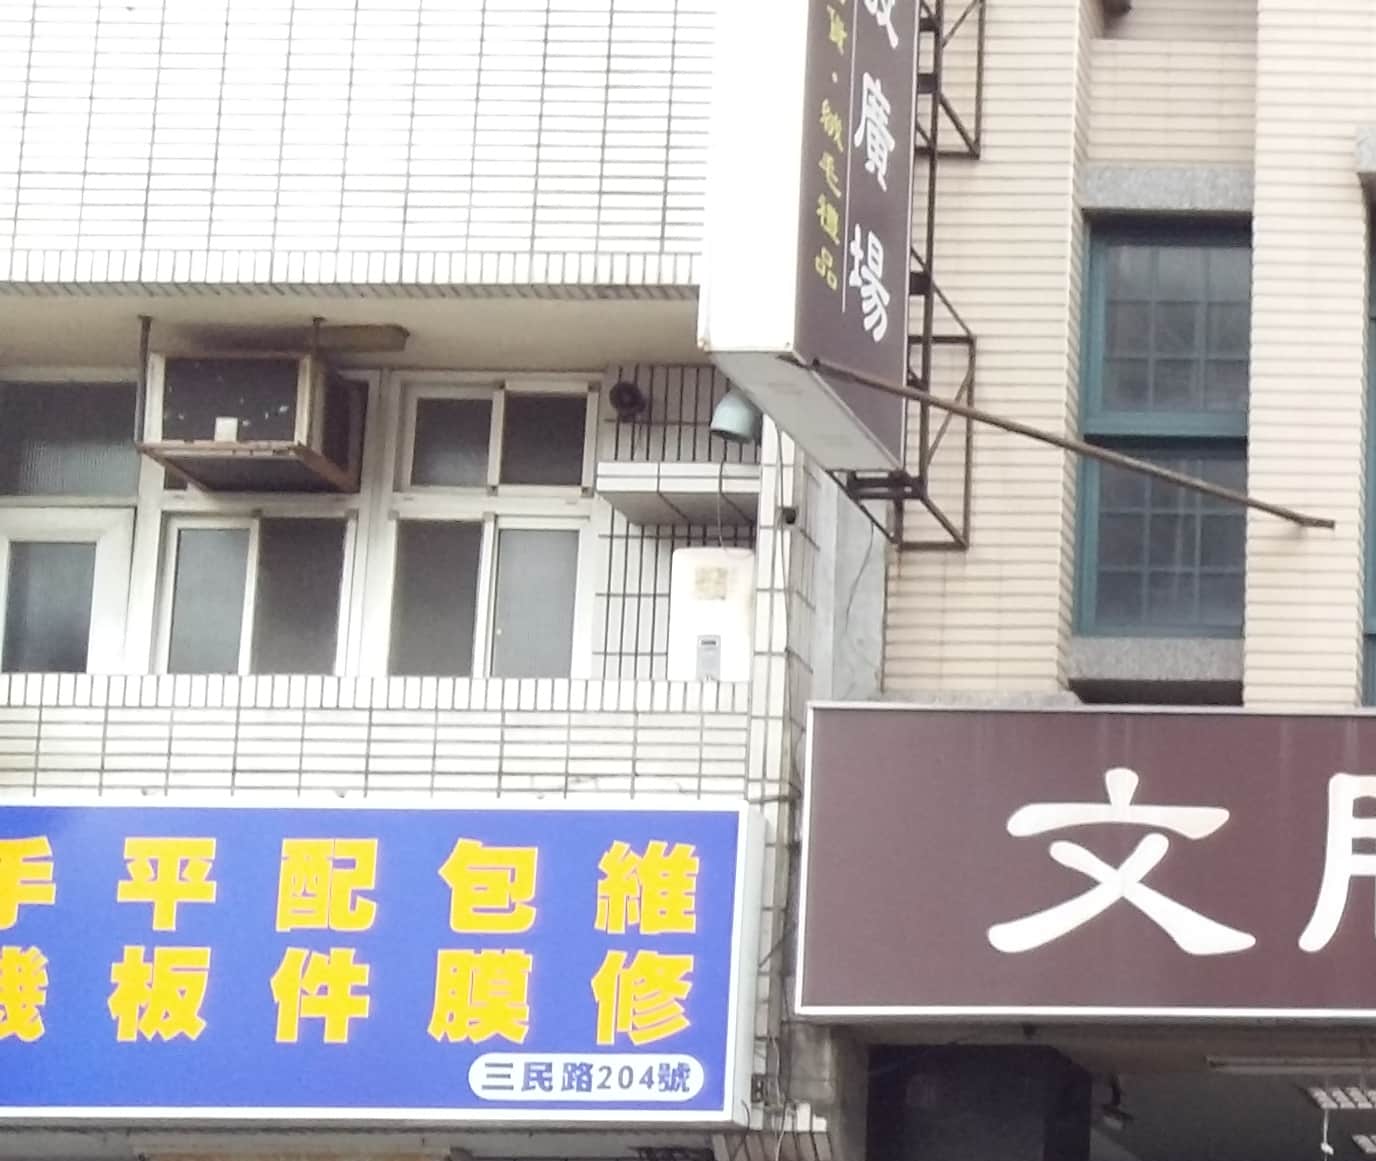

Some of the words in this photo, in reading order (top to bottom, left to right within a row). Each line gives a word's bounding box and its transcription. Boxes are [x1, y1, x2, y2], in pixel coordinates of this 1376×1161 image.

[108, 838, 217, 1042] 平板
[270, 838, 378, 1043] 配件
[427, 839, 538, 1044] 包膜
[590, 840, 699, 1045] 維修
[481, 1061, 692, 1093] 三民路204號
